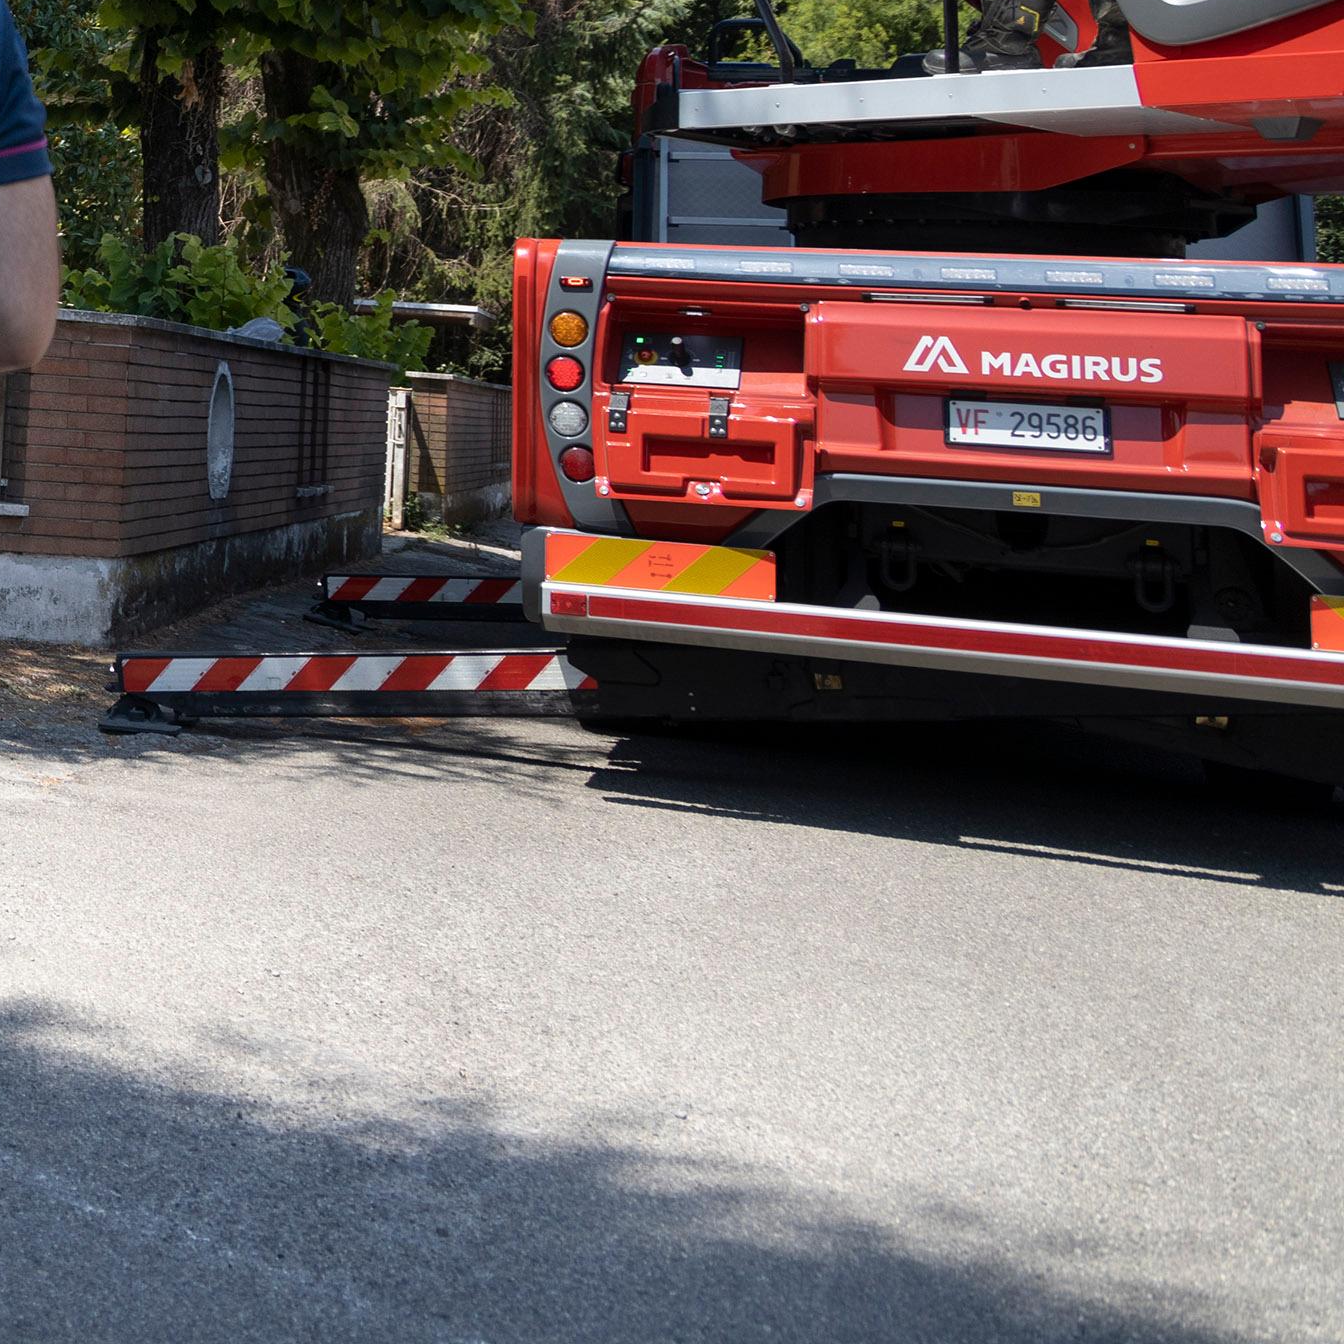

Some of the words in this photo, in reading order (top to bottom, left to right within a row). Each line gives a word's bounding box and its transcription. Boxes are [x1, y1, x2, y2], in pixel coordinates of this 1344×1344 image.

[981, 351, 1164, 384] MAGIRUS
[956, 408, 990, 435] VF
[1009, 411, 1098, 442] 29586
